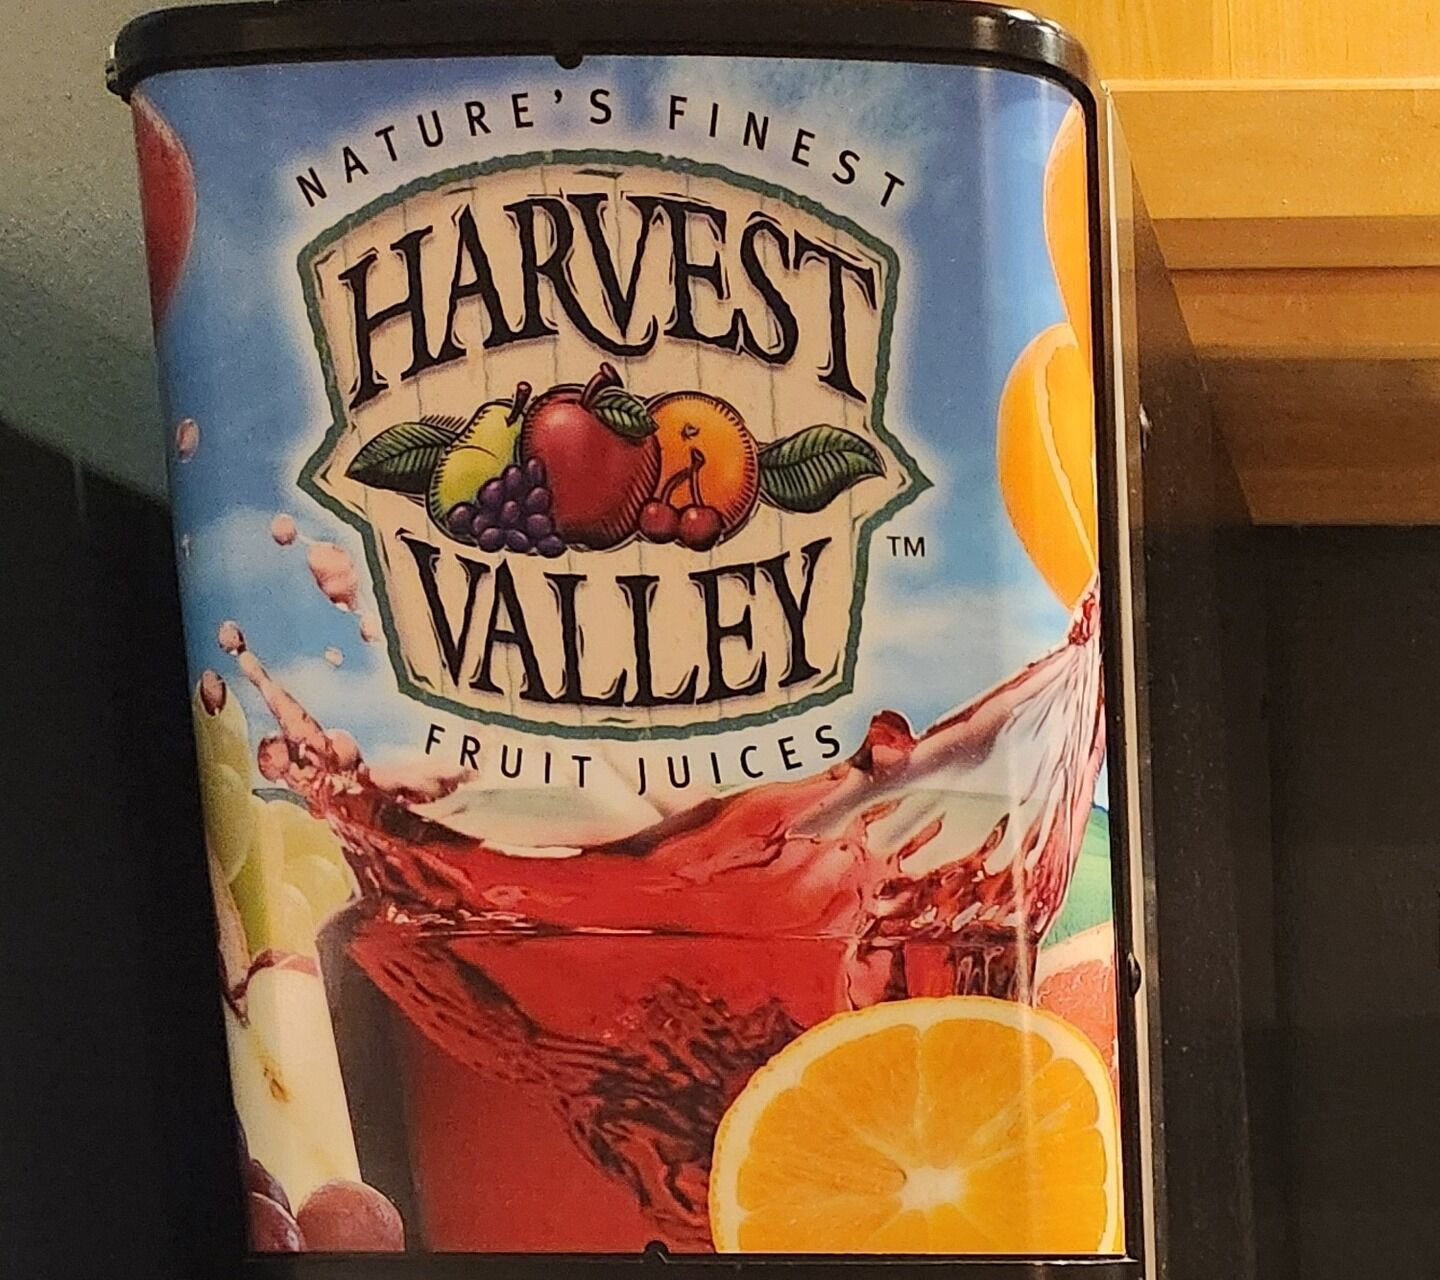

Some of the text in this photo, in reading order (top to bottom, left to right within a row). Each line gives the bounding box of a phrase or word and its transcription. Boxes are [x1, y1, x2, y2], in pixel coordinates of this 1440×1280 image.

[297, 88, 907, 209] NATURE'S FINEST
[340, 193, 876, 406] HARVEST
[396, 528, 834, 708] VALLEY
[425, 722, 842, 796] FRUIT JUICES
